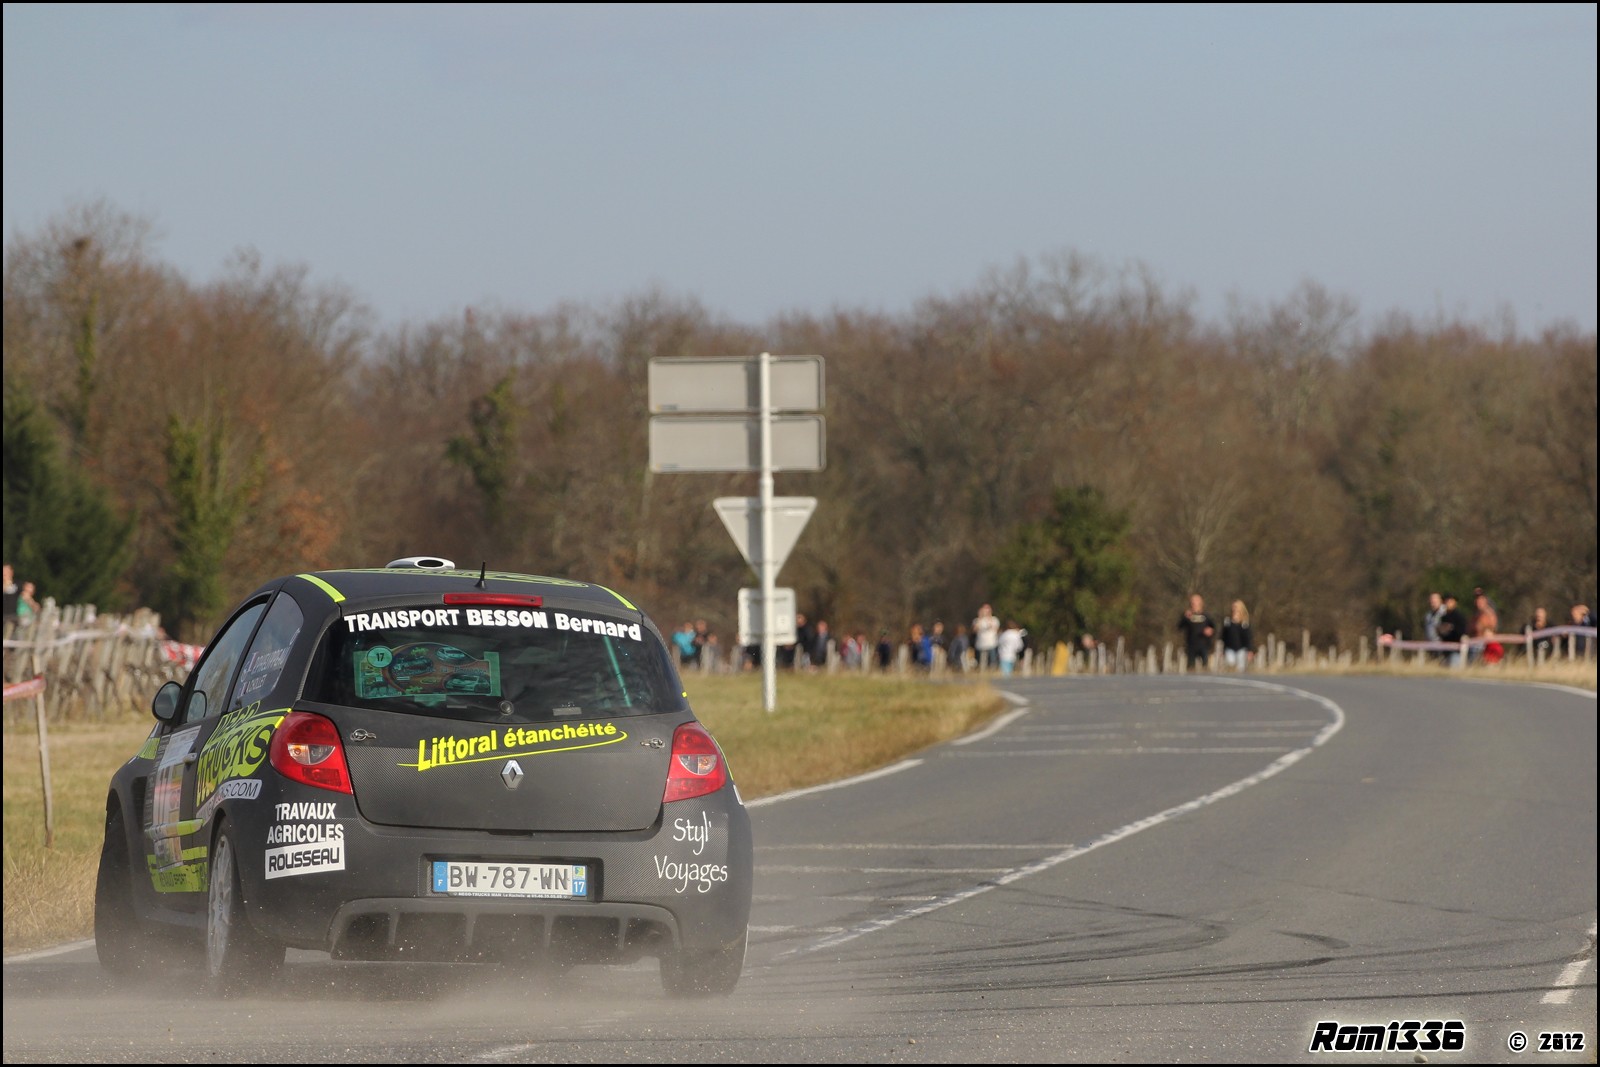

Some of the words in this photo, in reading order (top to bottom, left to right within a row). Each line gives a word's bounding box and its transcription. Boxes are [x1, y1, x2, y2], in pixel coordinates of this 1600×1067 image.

[344, 609, 460, 633] TRANSPORT
[466, 609, 549, 629] BESSON
[555, 612, 642, 641] Bernard
[376, 652, 385, 662] 17
[198, 723, 276, 790] TRUCKS
[418, 729, 497, 771] Littoral
[504, 722, 617, 748] étanchéité
[275, 802, 337, 821] TRAVAUX
[267, 823, 344, 845] AGRICOLES
[673, 811, 713, 855] Styl'
[269, 847, 340, 872] ROUSSEAU
[437, 879, 443, 887] F
[654, 855, 728, 893] Voyages
[573, 880, 585, 895] 17
